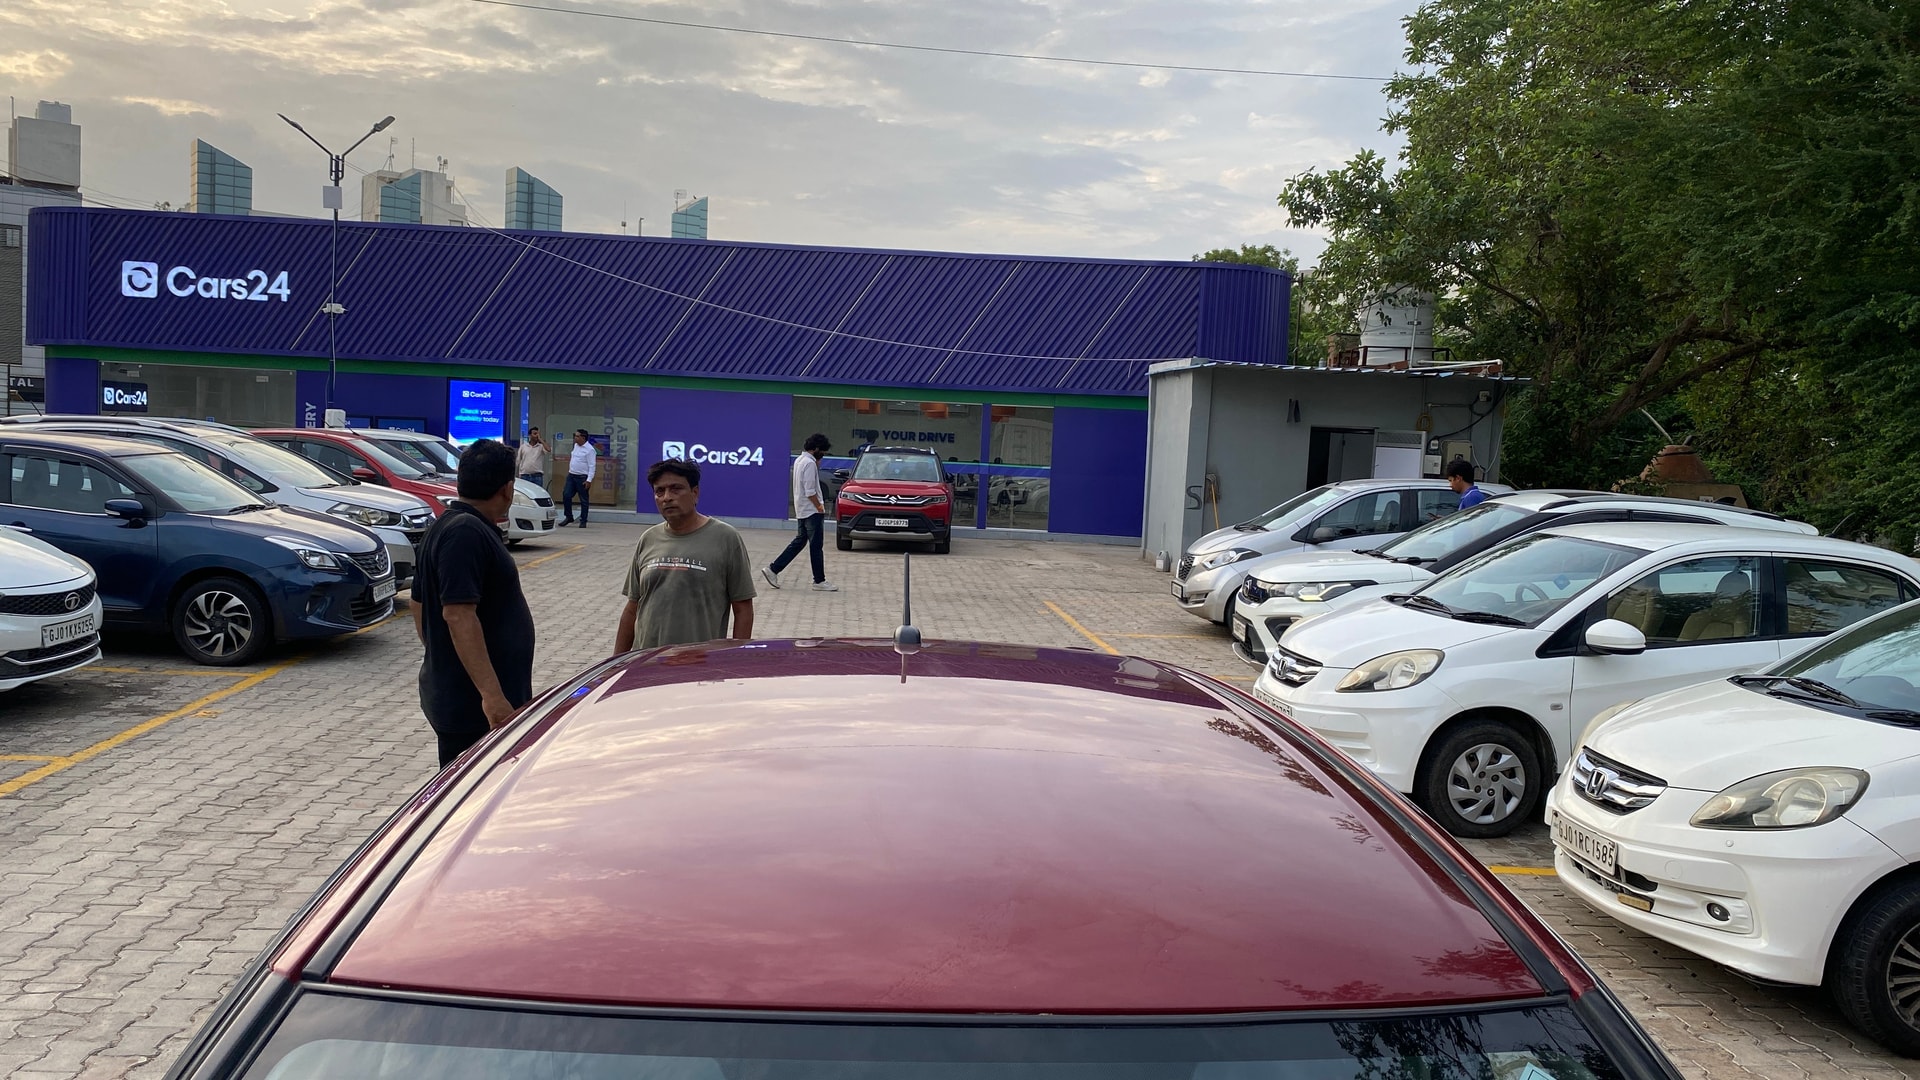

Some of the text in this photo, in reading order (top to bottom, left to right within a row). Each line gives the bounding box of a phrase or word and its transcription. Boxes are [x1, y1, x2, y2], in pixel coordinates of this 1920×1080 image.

[166, 265, 291, 302] Cars24
[115, 389, 147, 405] Cars24
[882, 430, 915, 441] YOUR
[919, 432, 955, 443] DRIVE
[689, 444, 764, 465] Cars24
[1558, 820, 1615, 867] GJ01RC1585
